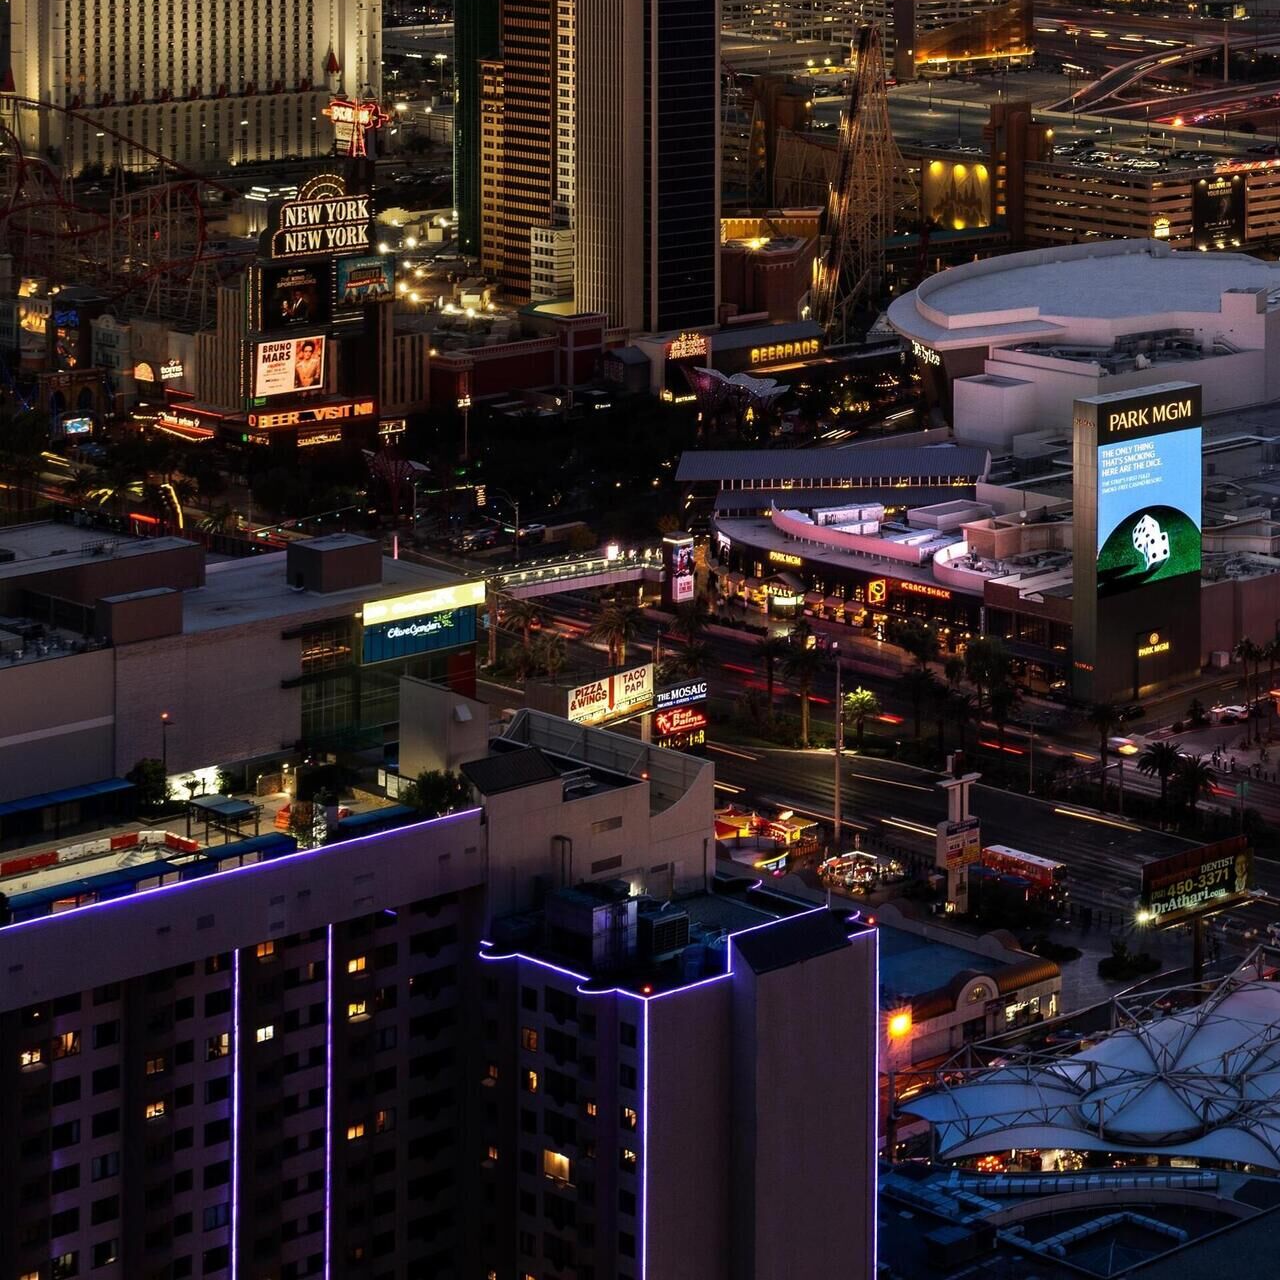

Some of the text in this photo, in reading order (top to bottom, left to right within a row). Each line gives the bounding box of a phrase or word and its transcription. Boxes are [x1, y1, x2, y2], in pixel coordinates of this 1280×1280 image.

[285, 199, 369, 227] NEW YORK
[285, 224, 369, 252] NEW YORK
[262, 342, 291, 354] BRUNO
[262, 351, 291, 364] MARS
[1109, 400, 1192, 432] PARK MGM
[1102, 442, 1154, 458] THE ONLY THING
[1124, 450, 1156, 462] SMOKING
[1102, 467, 1119, 477] HERE
[1120, 463, 1133, 473] ARE
[1133, 461, 1145, 470] THE
[769, 551, 801, 566] PARK MGM
[905, 582, 951, 599] CRACK SHACK
[387, 627, 410, 638] Olive
[409, 621, 441, 636] Garden
[1138, 642, 1169, 657] PARK MGM
[622, 668, 647, 683] TACO
[575, 682, 603, 699] PIZZA
[625, 680, 644, 694] PAPI
[656, 683, 707, 701] THE MOSAIC
[570, 690, 607, 711] & WINGS
[673, 710, 692, 720] Red
[673, 714, 703, 727] Palms
[1201, 856, 1234, 873] DENTIST
[1167, 868, 1229, 898] 450-3371
[1151, 887, 1227, 915] DrAthari.com
